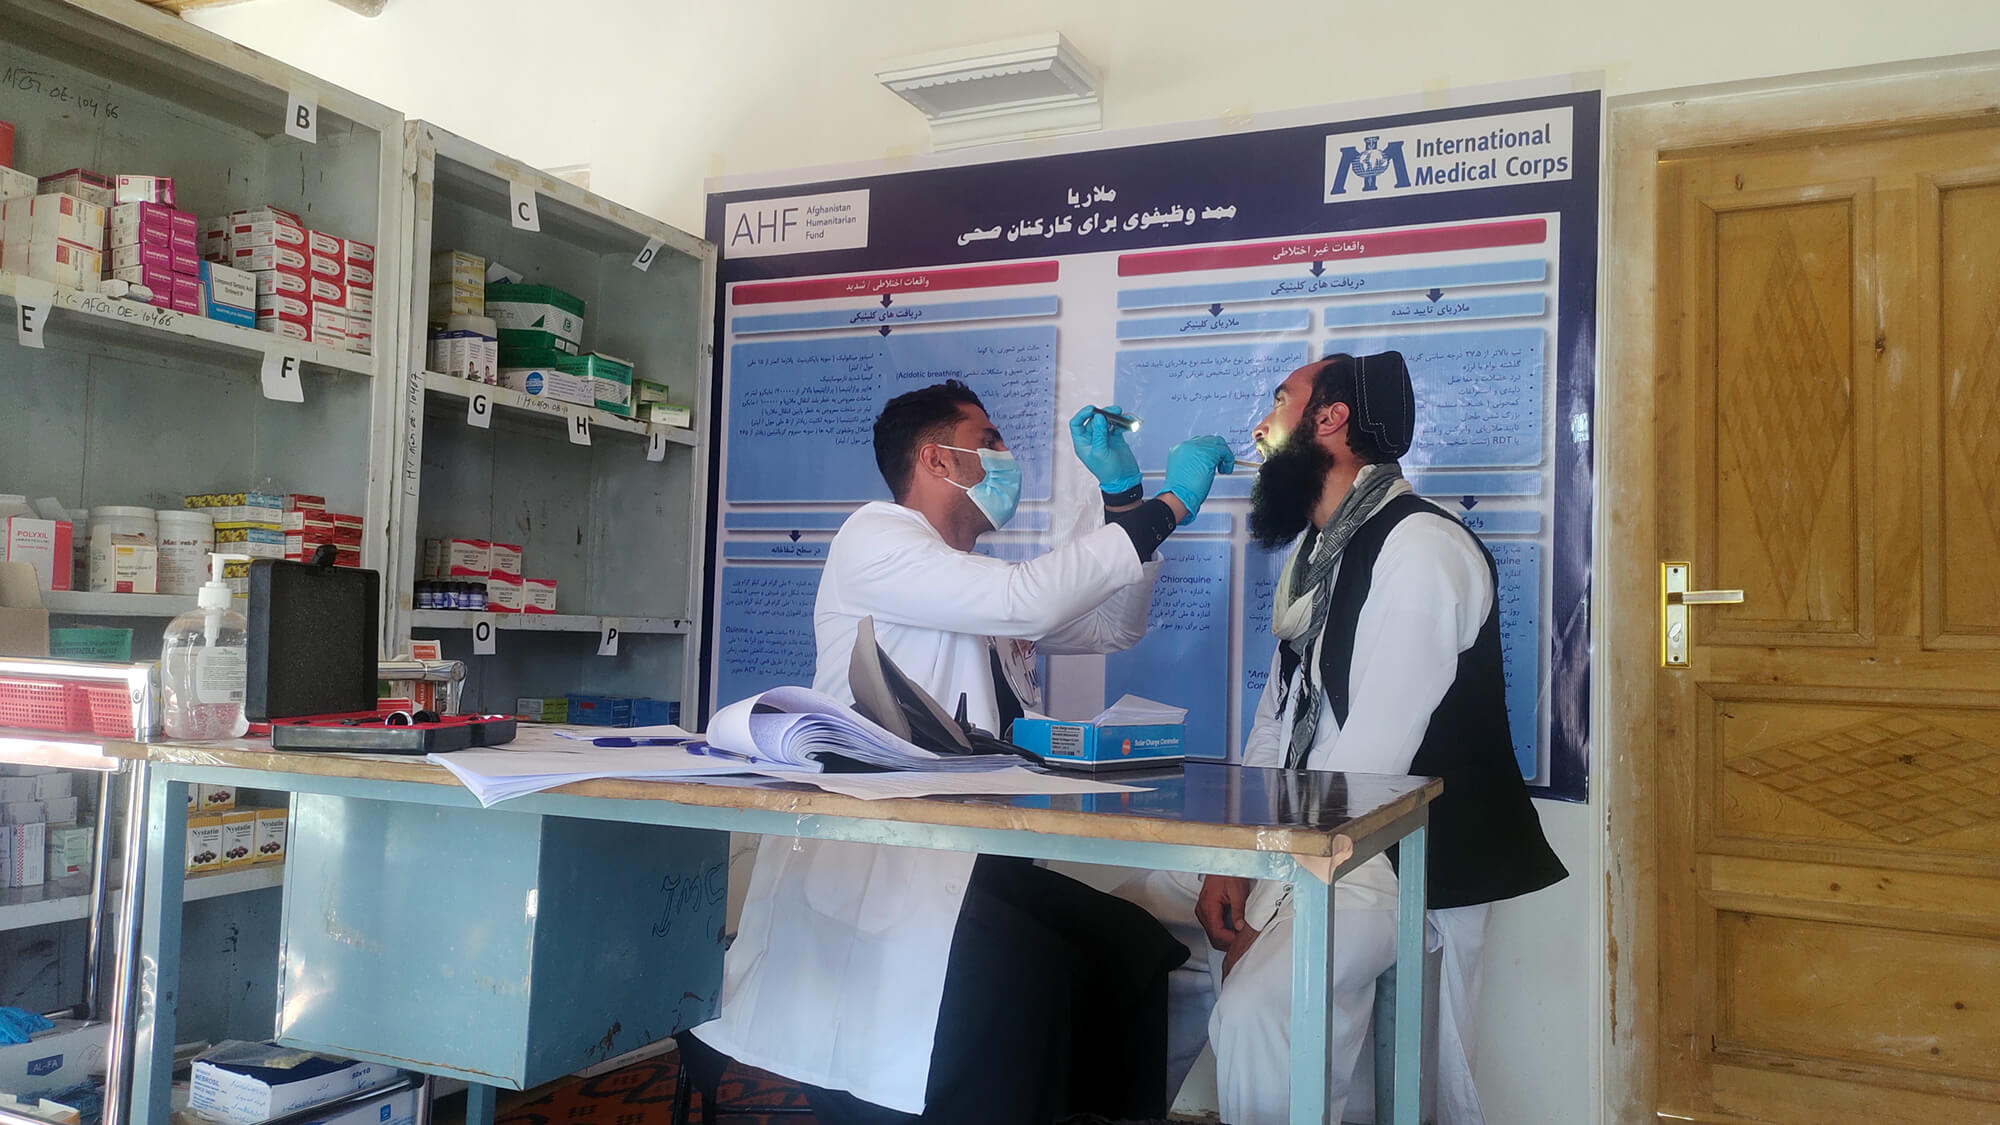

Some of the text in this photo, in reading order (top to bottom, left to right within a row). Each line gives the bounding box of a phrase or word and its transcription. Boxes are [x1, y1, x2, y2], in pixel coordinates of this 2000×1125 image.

[296, 105, 310, 129] B
[1416, 123, 1551, 158] International
[1415, 156, 1568, 187] Medical Corps
[1067, 185, 1117, 209] ملاریا
[518, 202, 530, 221] C
[807, 204, 851, 217] Afghanistan
[731, 208, 798, 246] AHF
[806, 216, 856, 227] Humanitarian
[1007, 215, 1072, 242] کارکنان
[1077, 213, 1117, 235] برای
[805, 230, 824, 240] Fund
[957, 225, 1002, 246] صحی
[638, 248, 653, 264] D
[1272, 241, 1364, 261] واقعات غیر اختلاطی
[846, 280, 866, 292] شدید
[904, 275, 929, 288] واقعات
[1271, 277, 1365, 295] دریافت های کلینیکی
[878, 310, 894, 322] های
[896, 308, 922, 320] دریافت
[1391, 306, 1411, 316] شده
[1437, 303, 1470, 317] ملاریای
[21, 305, 36, 333] E
[1210, 318, 1240, 329] ملاریای
[281, 356, 295, 378] F
[473, 395, 487, 415] G
[576, 415, 587, 435] H
[1492, 436, 1513, 445] RDT
[1160, 575, 1212, 585] Chloroquine
[476, 621, 490, 642] O
[606, 627, 617, 646] P
[1134, 738, 1180, 747] Solar Charge Controller
[192, 827, 219, 839] Nystatin
[225, 823, 251, 835] Nystatin
[261, 819, 284, 830] Nystatin
